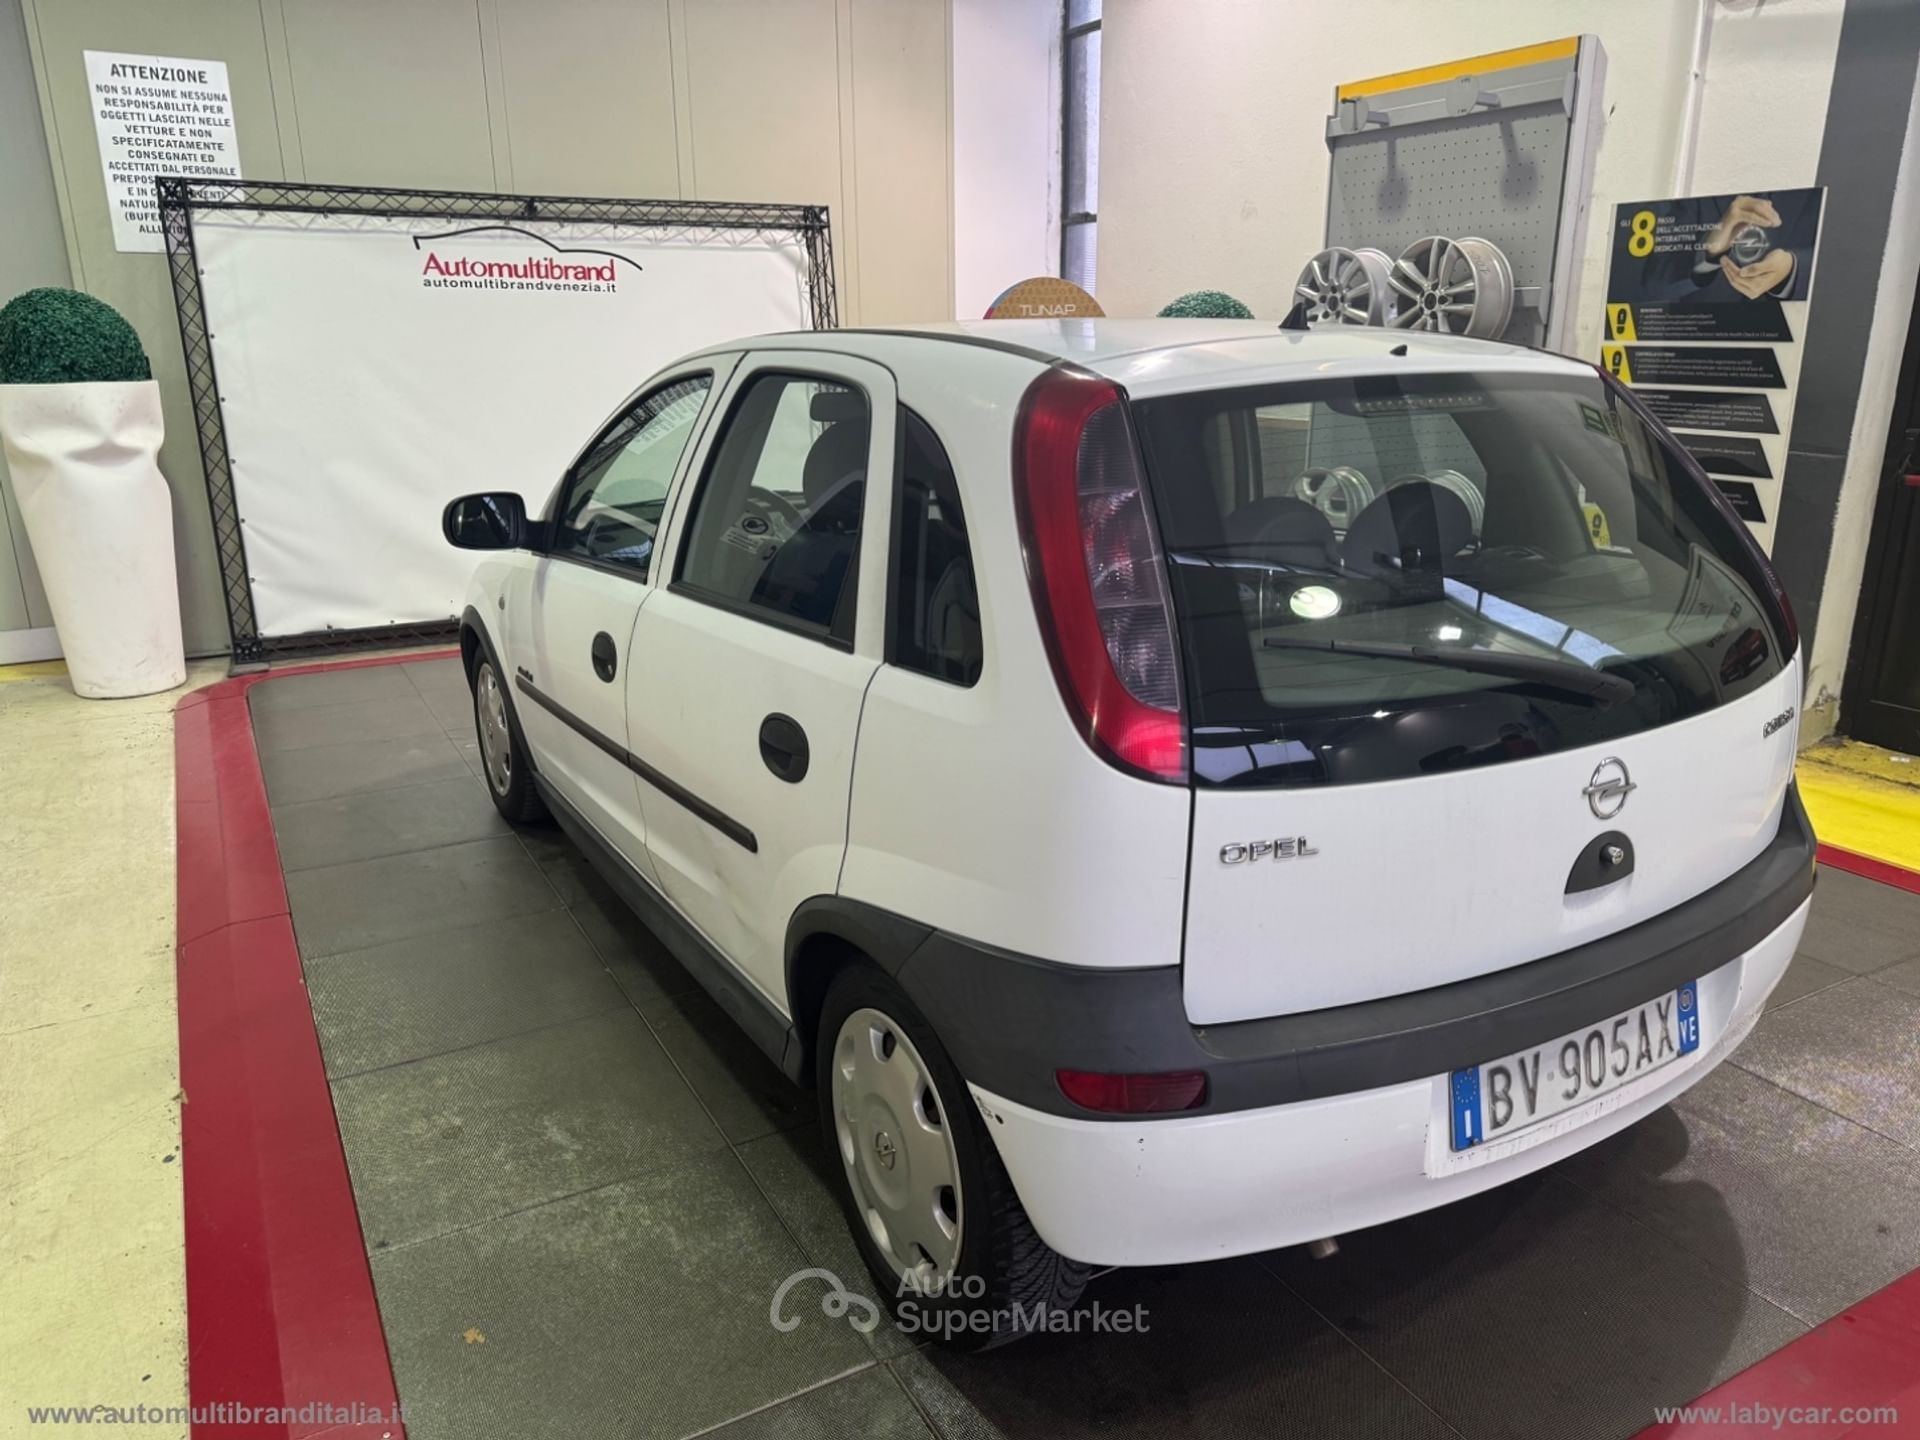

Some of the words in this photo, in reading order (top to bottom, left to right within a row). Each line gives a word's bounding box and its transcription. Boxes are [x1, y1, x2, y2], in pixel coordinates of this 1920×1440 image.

[110, 63, 208, 84] ATTENZIONE
[95, 84, 118, 94] NON
[121, 86, 132, 95] SI
[135, 87, 177, 99] ASSUME
[180, 90, 228, 102] NESSUNA
[104, 97, 199, 113] RESPONSABILITÀ
[202, 104, 224, 114] PER
[100, 110, 145, 122] OGGETTI
[149, 113, 195, 125] LASCIATI
[198, 116, 231, 127] NELLE
[125, 124, 175, 136] VETTURE
[179, 127, 186, 137] E
[189, 128, 212, 138] NON
[112, 136, 224, 151] SPECIFICATAMENTE
[128, 150, 197, 162] CONSEGNATI
[200, 153, 215, 163] ED
[109, 161, 159, 172] ACCETTATI
[161, 163, 180, 173] DAL
[182, 165, 236, 176] PERSONALE
[127, 187, 134, 196] E
[137, 187, 148, 197] IN
[1628, 211, 1656, 257] 8
[422, 253, 616, 281] Automultibrand
[423, 277, 616, 293] automultibrandvenezia.it
[1019, 303, 1076, 316] TUNAP
[1219, 836, 1320, 864] OPEL
[1680, 1015, 1697, 1044] VE
